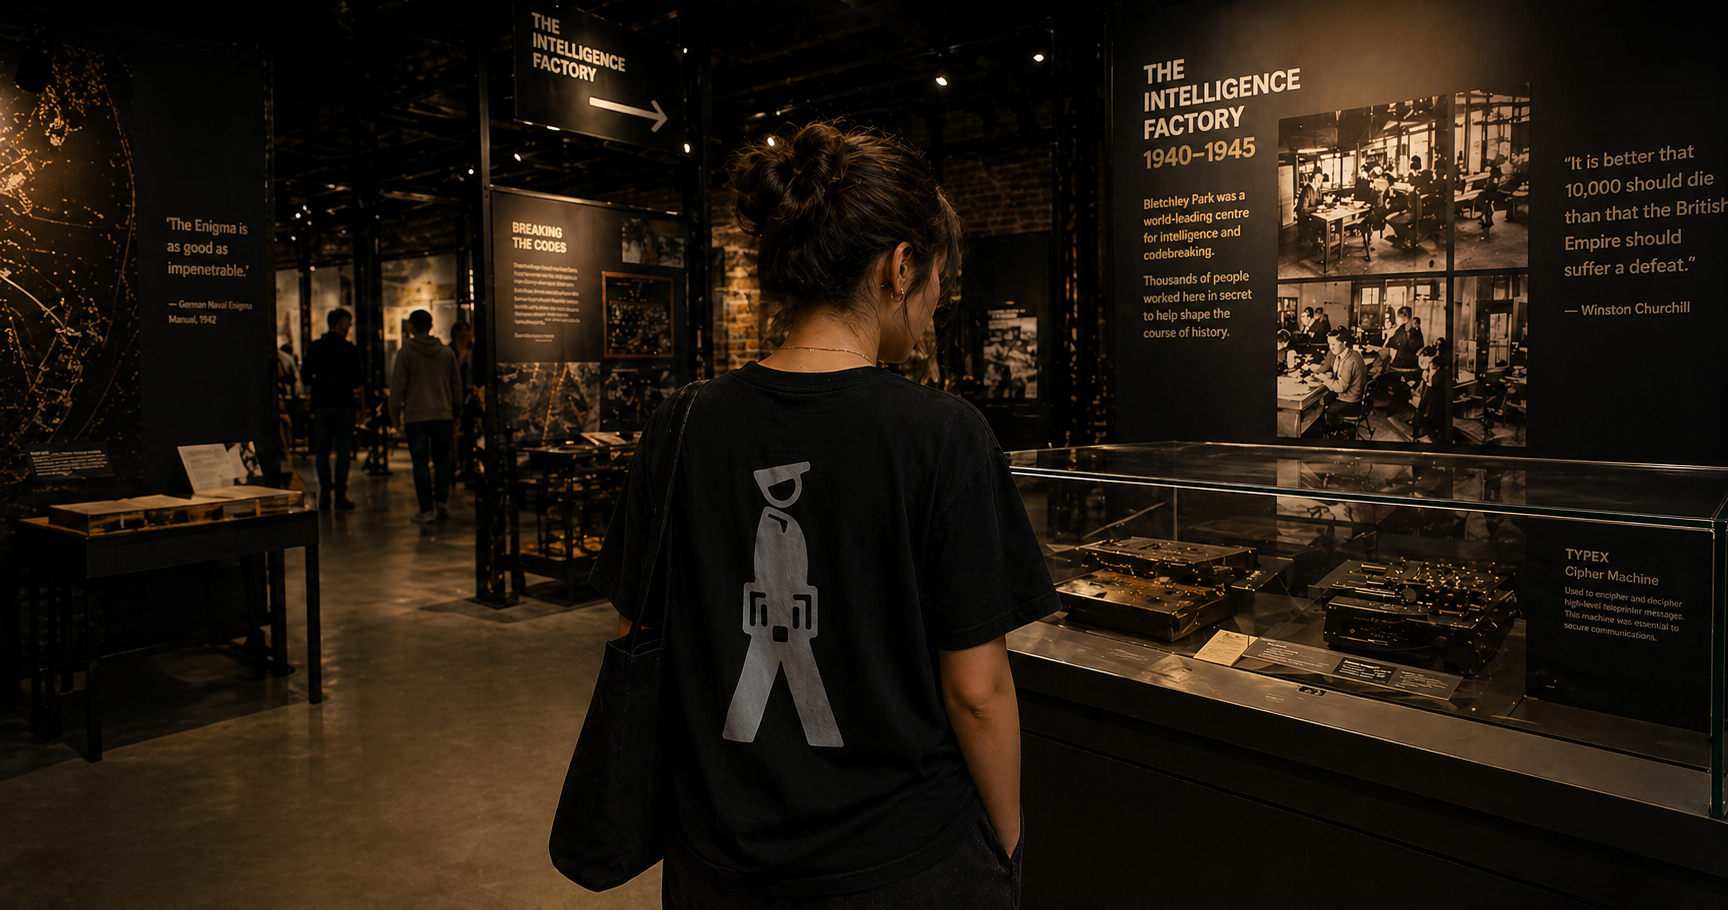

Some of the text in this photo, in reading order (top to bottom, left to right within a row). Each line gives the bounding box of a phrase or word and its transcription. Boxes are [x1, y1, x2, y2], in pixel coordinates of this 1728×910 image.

[531, 11, 561, 35] THE
[532, 31, 626, 73] INTELLIGENCE
[532, 51, 597, 82] FACTORY
[1144, 58, 1185, 85] THE
[1144, 67, 1300, 112] INTELLIGENCE
[1144, 105, 1244, 140] FACTORY
[1587, 154, 1599, 169] is
[1604, 150, 1654, 167] better
[1659, 144, 1694, 161] that
[1565, 170, 1714, 198] 10,000 should die
[1143, 191, 1246, 210] Bletchley Park was a
[1143, 208, 1249, 227] world-leading centre
[1565, 197, 1728, 224] than that the British
[195, 219, 236, 236] Enigma
[239, 222, 248, 235] is
[512, 221, 562, 239] BREAKING
[1143, 224, 1241, 243] for intelligence and
[167, 241, 228, 256] as good as
[512, 237, 567, 253] THE CODES
[1565, 228, 1682, 252] Empire should
[1143, 245, 1215, 261] codebreaking.
[1565, 260, 1611, 277] suffer
[1615, 263, 1624, 275] a
[1143, 270, 1249, 287] Thousands of people
[1143, 288, 1252, 304] worked here in secret
[179, 300, 206, 309] German
[208, 301, 227, 309] Naval
[228, 301, 252, 311] Enigma
[1581, 304, 1631, 316] Winston
[1635, 301, 1690, 314] Churchill
[168, 315, 217, 324] Manual, 1942
[1143, 307, 1230, 323] to help shape the
[1143, 325, 1230, 340] course of history.
[1565, 548, 1609, 563] TYPEX
[1565, 565, 1659, 585] Cipher Machine
[1586, 589, 1594, 597] to
[1595, 591, 1629, 601] encipher
[1631, 595, 1645, 603] and
[1647, 597, 1683, 607] decipher
[1564, 610, 1580, 618] This
[1582, 613, 1614, 623] machine
[1564, 623, 1658, 641] secure communications.
